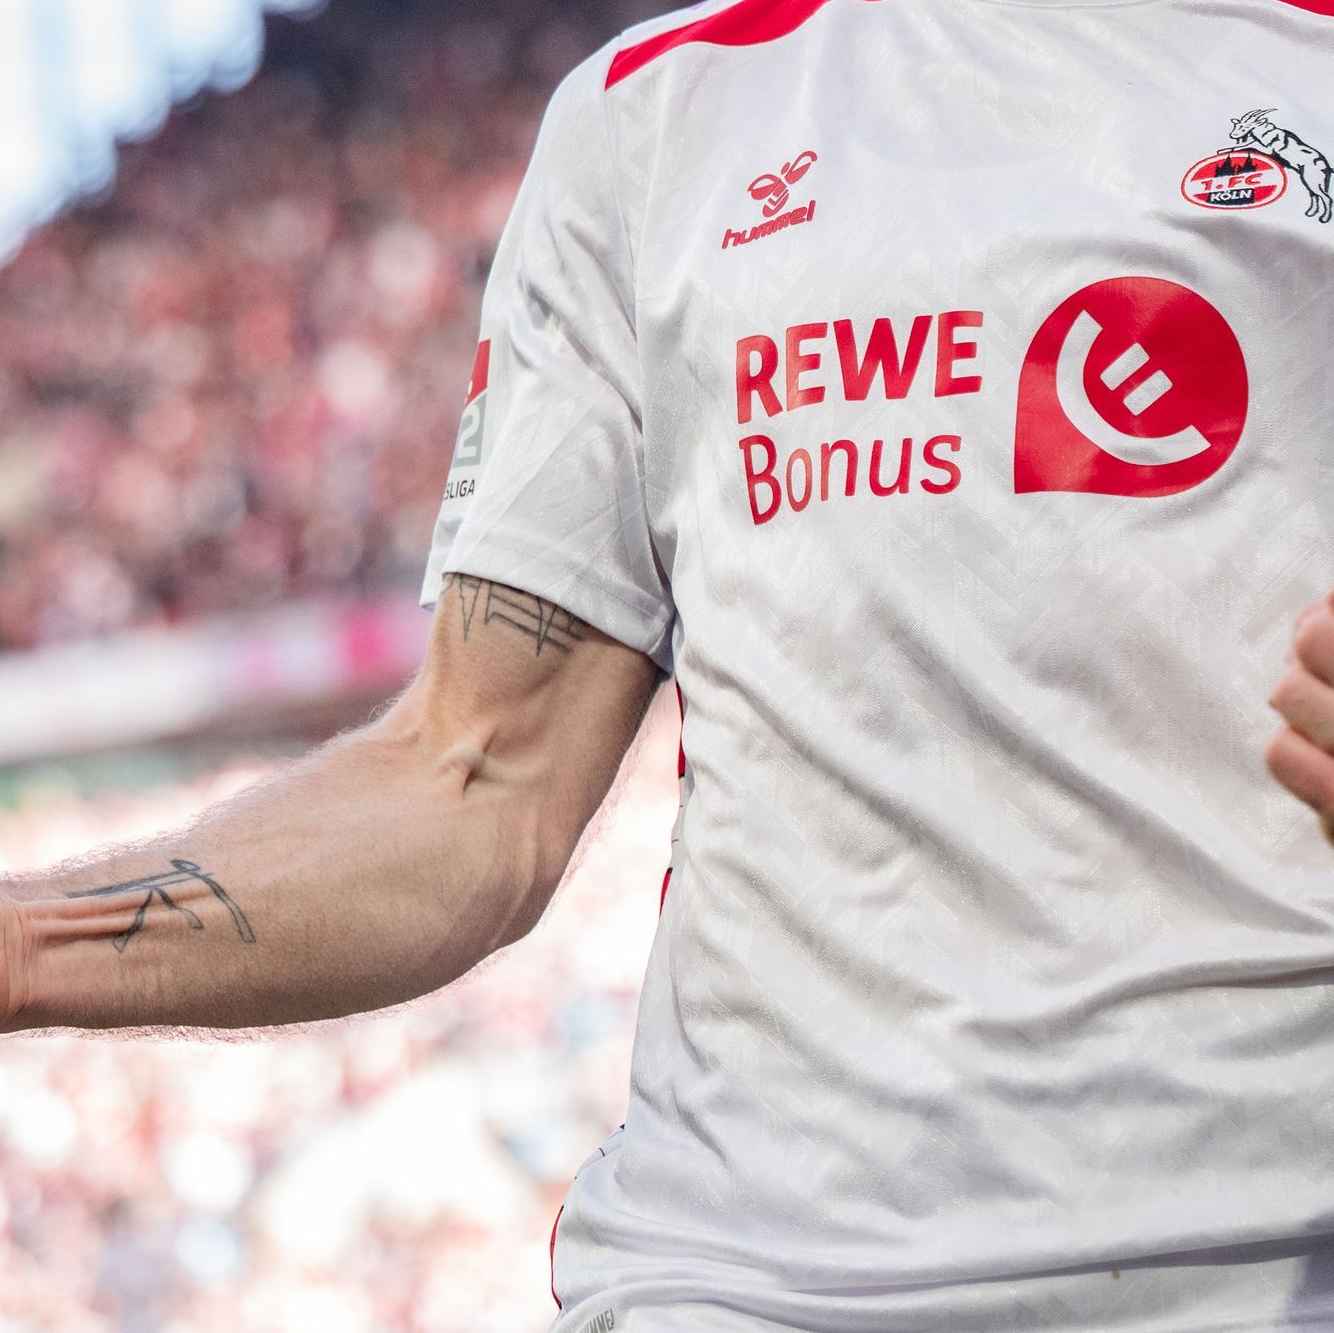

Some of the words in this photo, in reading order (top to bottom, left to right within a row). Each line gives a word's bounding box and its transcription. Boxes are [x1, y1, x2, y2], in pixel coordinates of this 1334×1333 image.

[722, 199, 816, 249] hummel
[1210, 189, 1253, 202] KÖLN
[735, 310, 984, 424] REWE
[738, 434, 962, 525] Bonus
